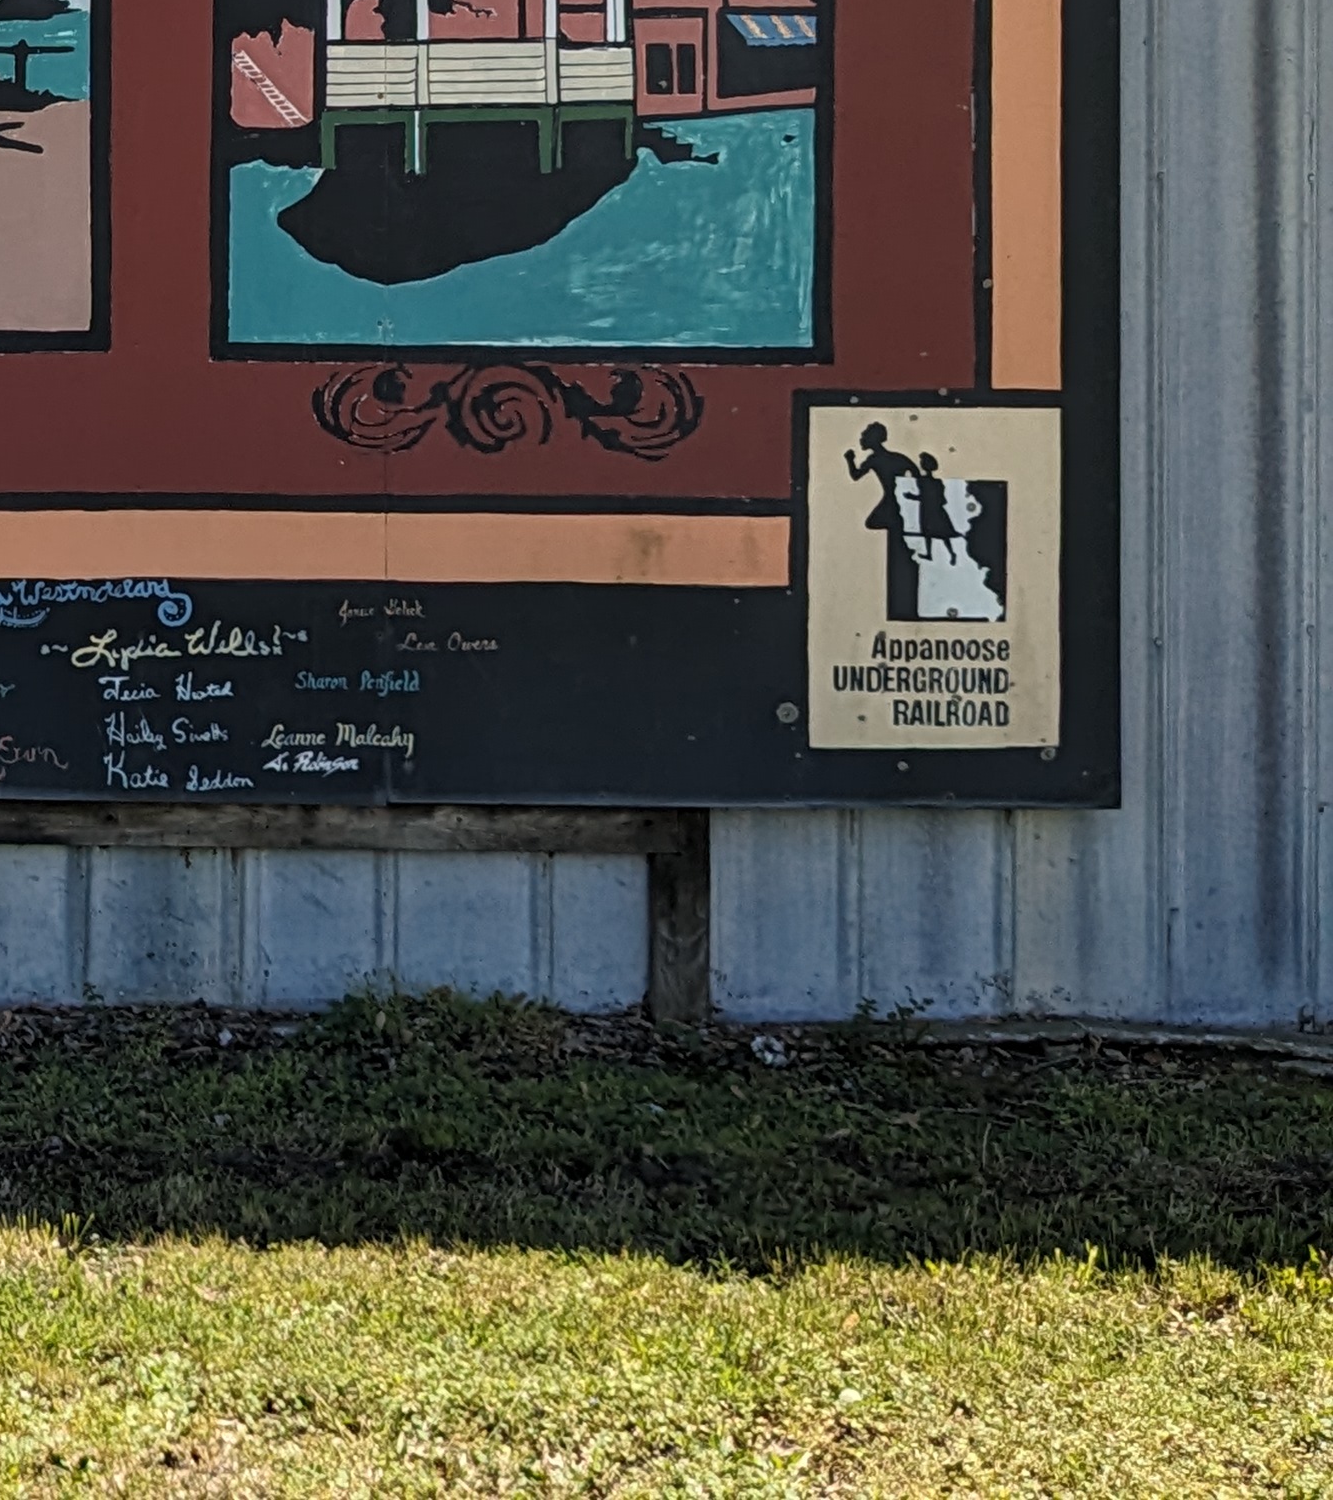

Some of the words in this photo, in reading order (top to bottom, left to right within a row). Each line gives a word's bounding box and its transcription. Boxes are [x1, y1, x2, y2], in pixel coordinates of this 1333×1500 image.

[72, 629, 182, 670] Lydia
[871, 636, 1010, 661] Appanoose
[295, 670, 349, 692] Sharon
[833, 666, 1010, 694] UNDERGROUND
[892, 699, 1010, 727] RAILROAD
[103, 750, 170, 788] Katie
